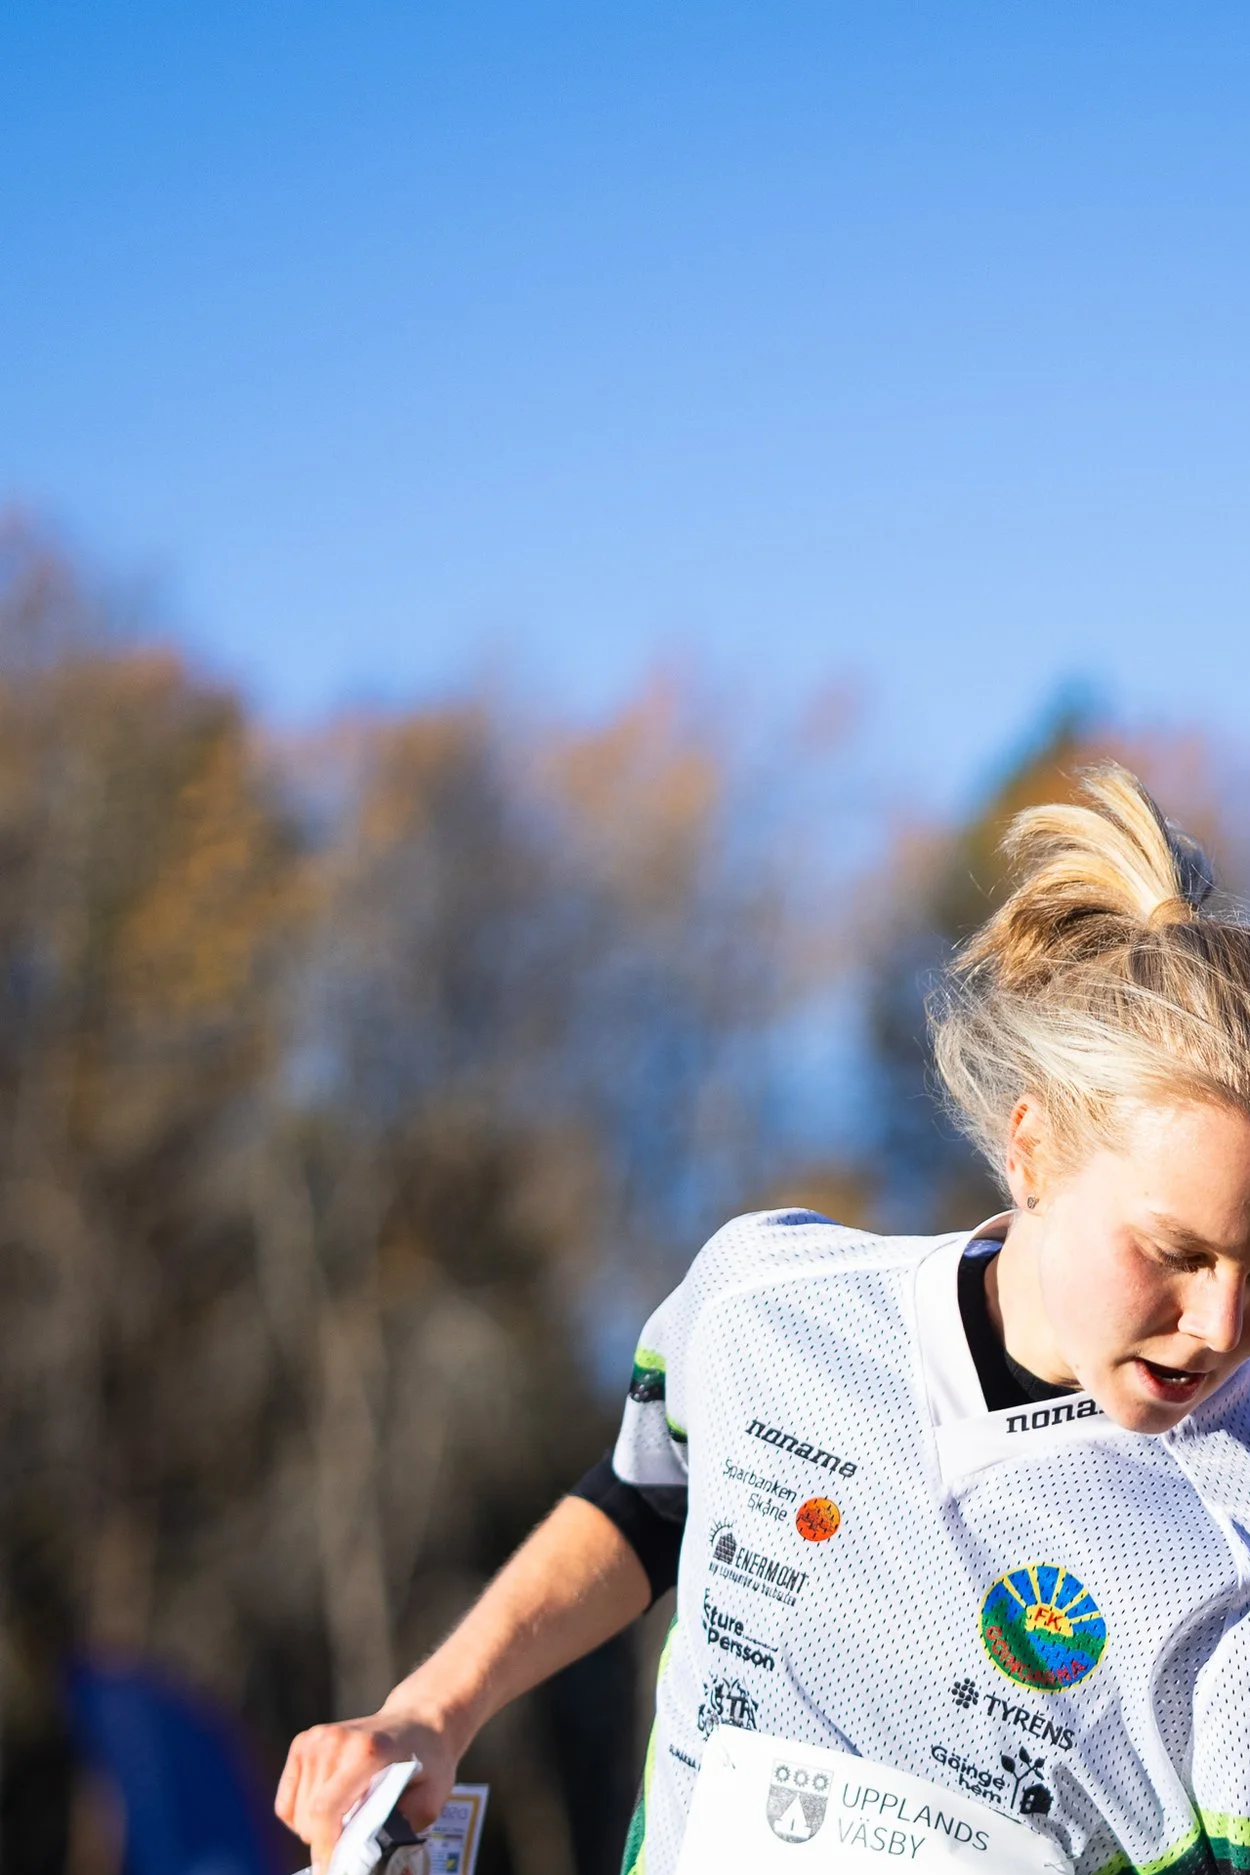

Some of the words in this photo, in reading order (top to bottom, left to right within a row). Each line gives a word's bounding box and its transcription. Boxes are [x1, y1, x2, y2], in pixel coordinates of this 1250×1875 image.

[1006, 1398, 1105, 1433] nona
[745, 1419, 857, 1478] noname
[723, 1458, 798, 1504] Sparbanken
[747, 1493, 788, 1522] Skåne
[735, 1547, 809, 1594] ENERMONT
[1033, 1606, 1064, 1630] FK
[984, 1694, 1076, 1751] TYRÉNS
[931, 1745, 1006, 1789] Göinge
[958, 1773, 1002, 1805] hem
[838, 1818, 926, 1860] VÄSBY
[841, 1782, 990, 1852] UPPLANDS
